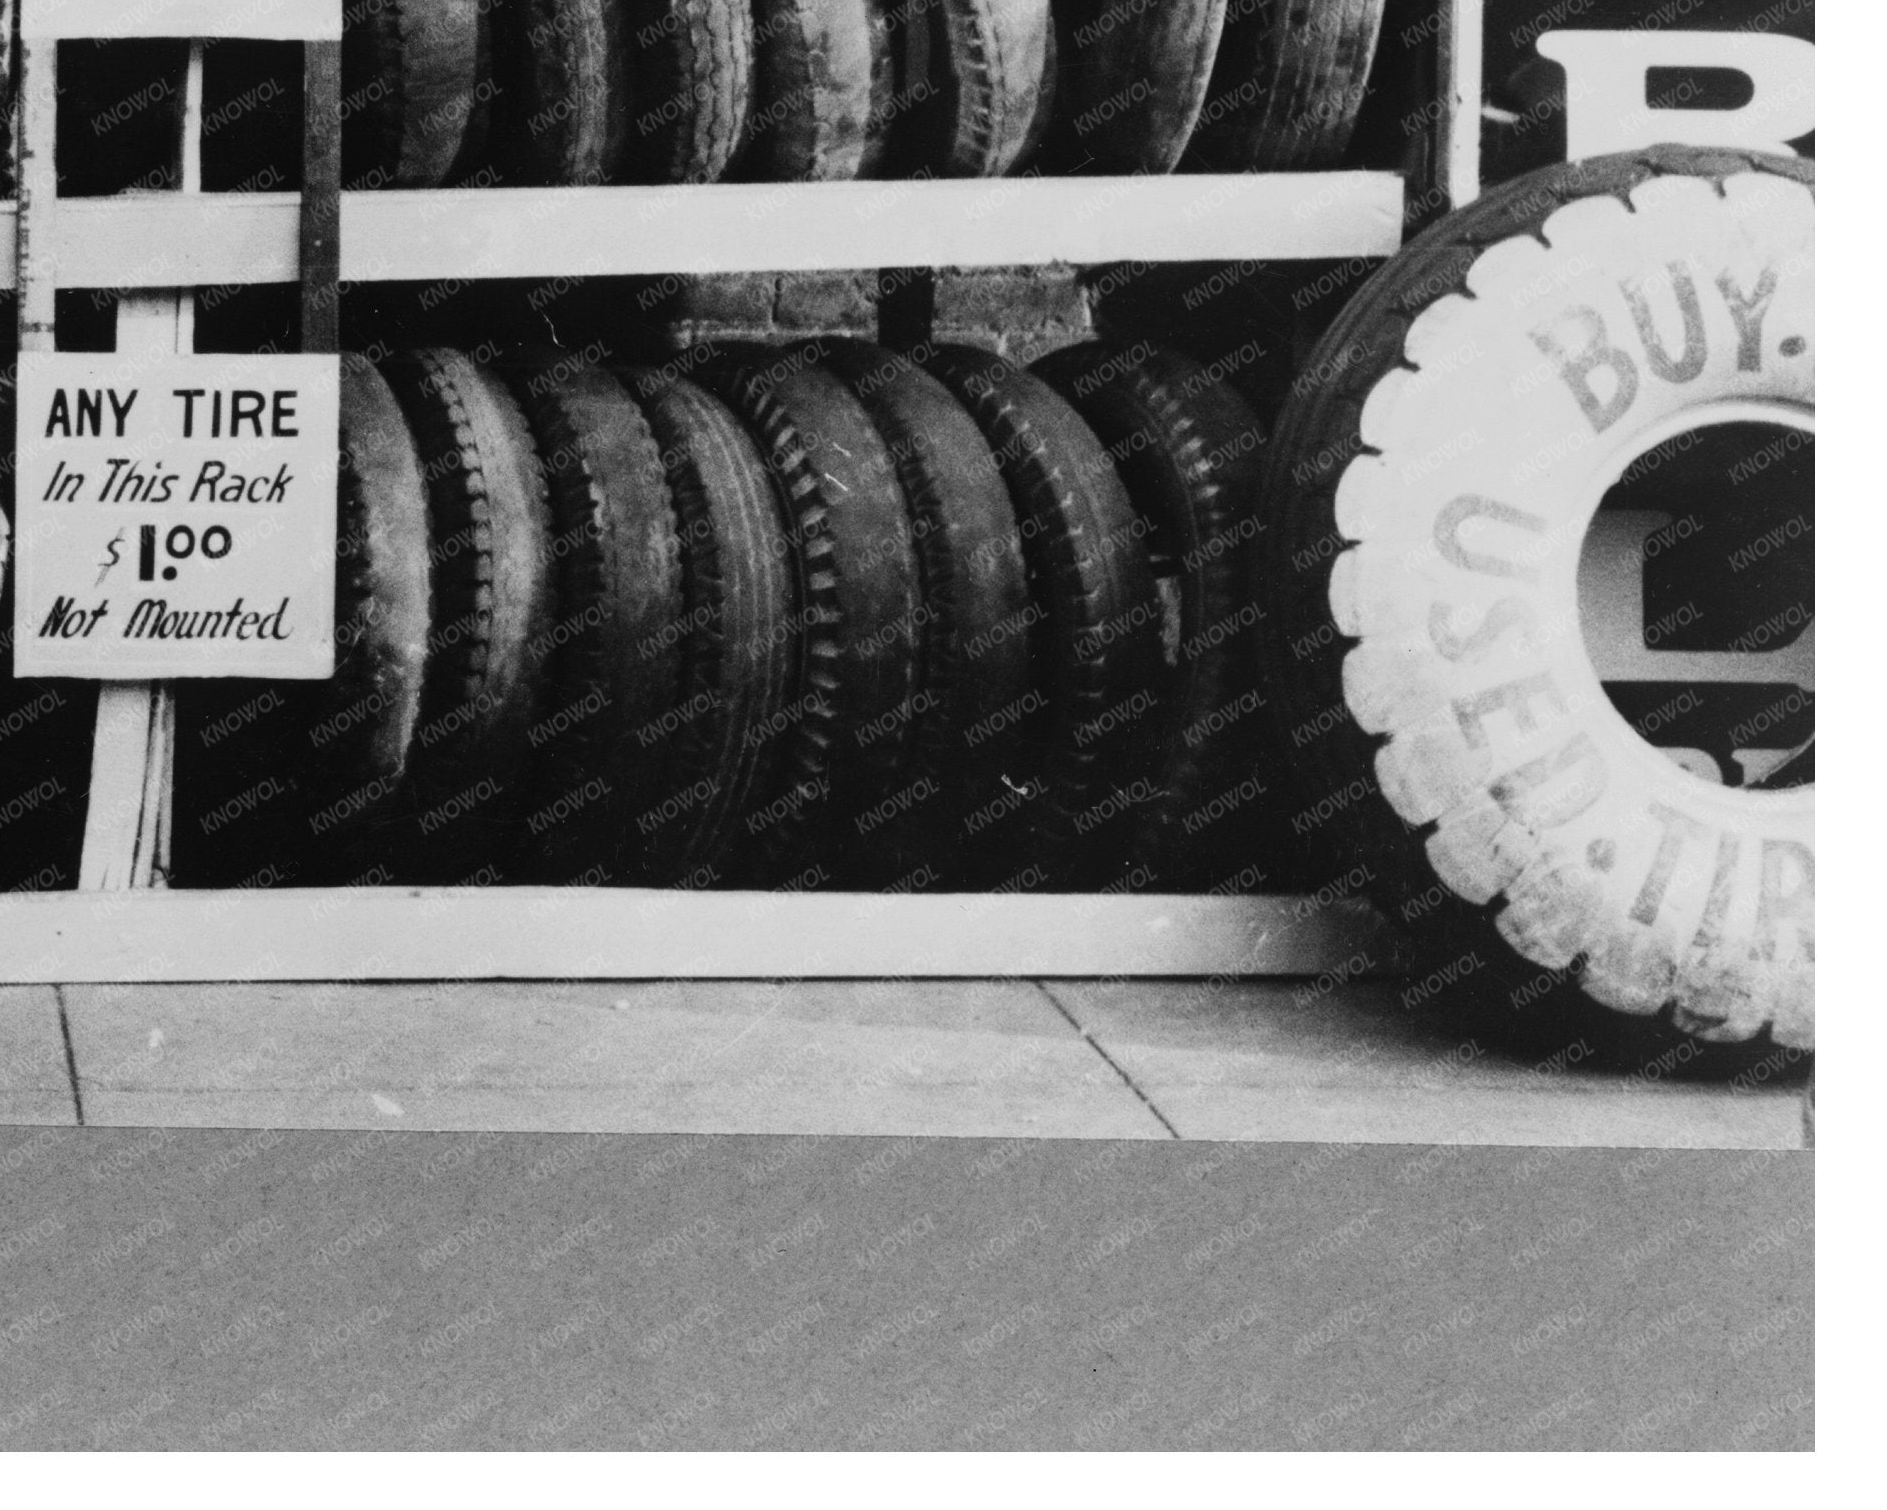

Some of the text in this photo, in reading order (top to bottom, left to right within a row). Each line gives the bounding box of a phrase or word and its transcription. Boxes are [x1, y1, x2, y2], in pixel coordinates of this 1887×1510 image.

[44, 388, 300, 439] ANY TIRE
[42, 458, 295, 504] In This Rack
[38, 596, 294, 641] Not Mounted
